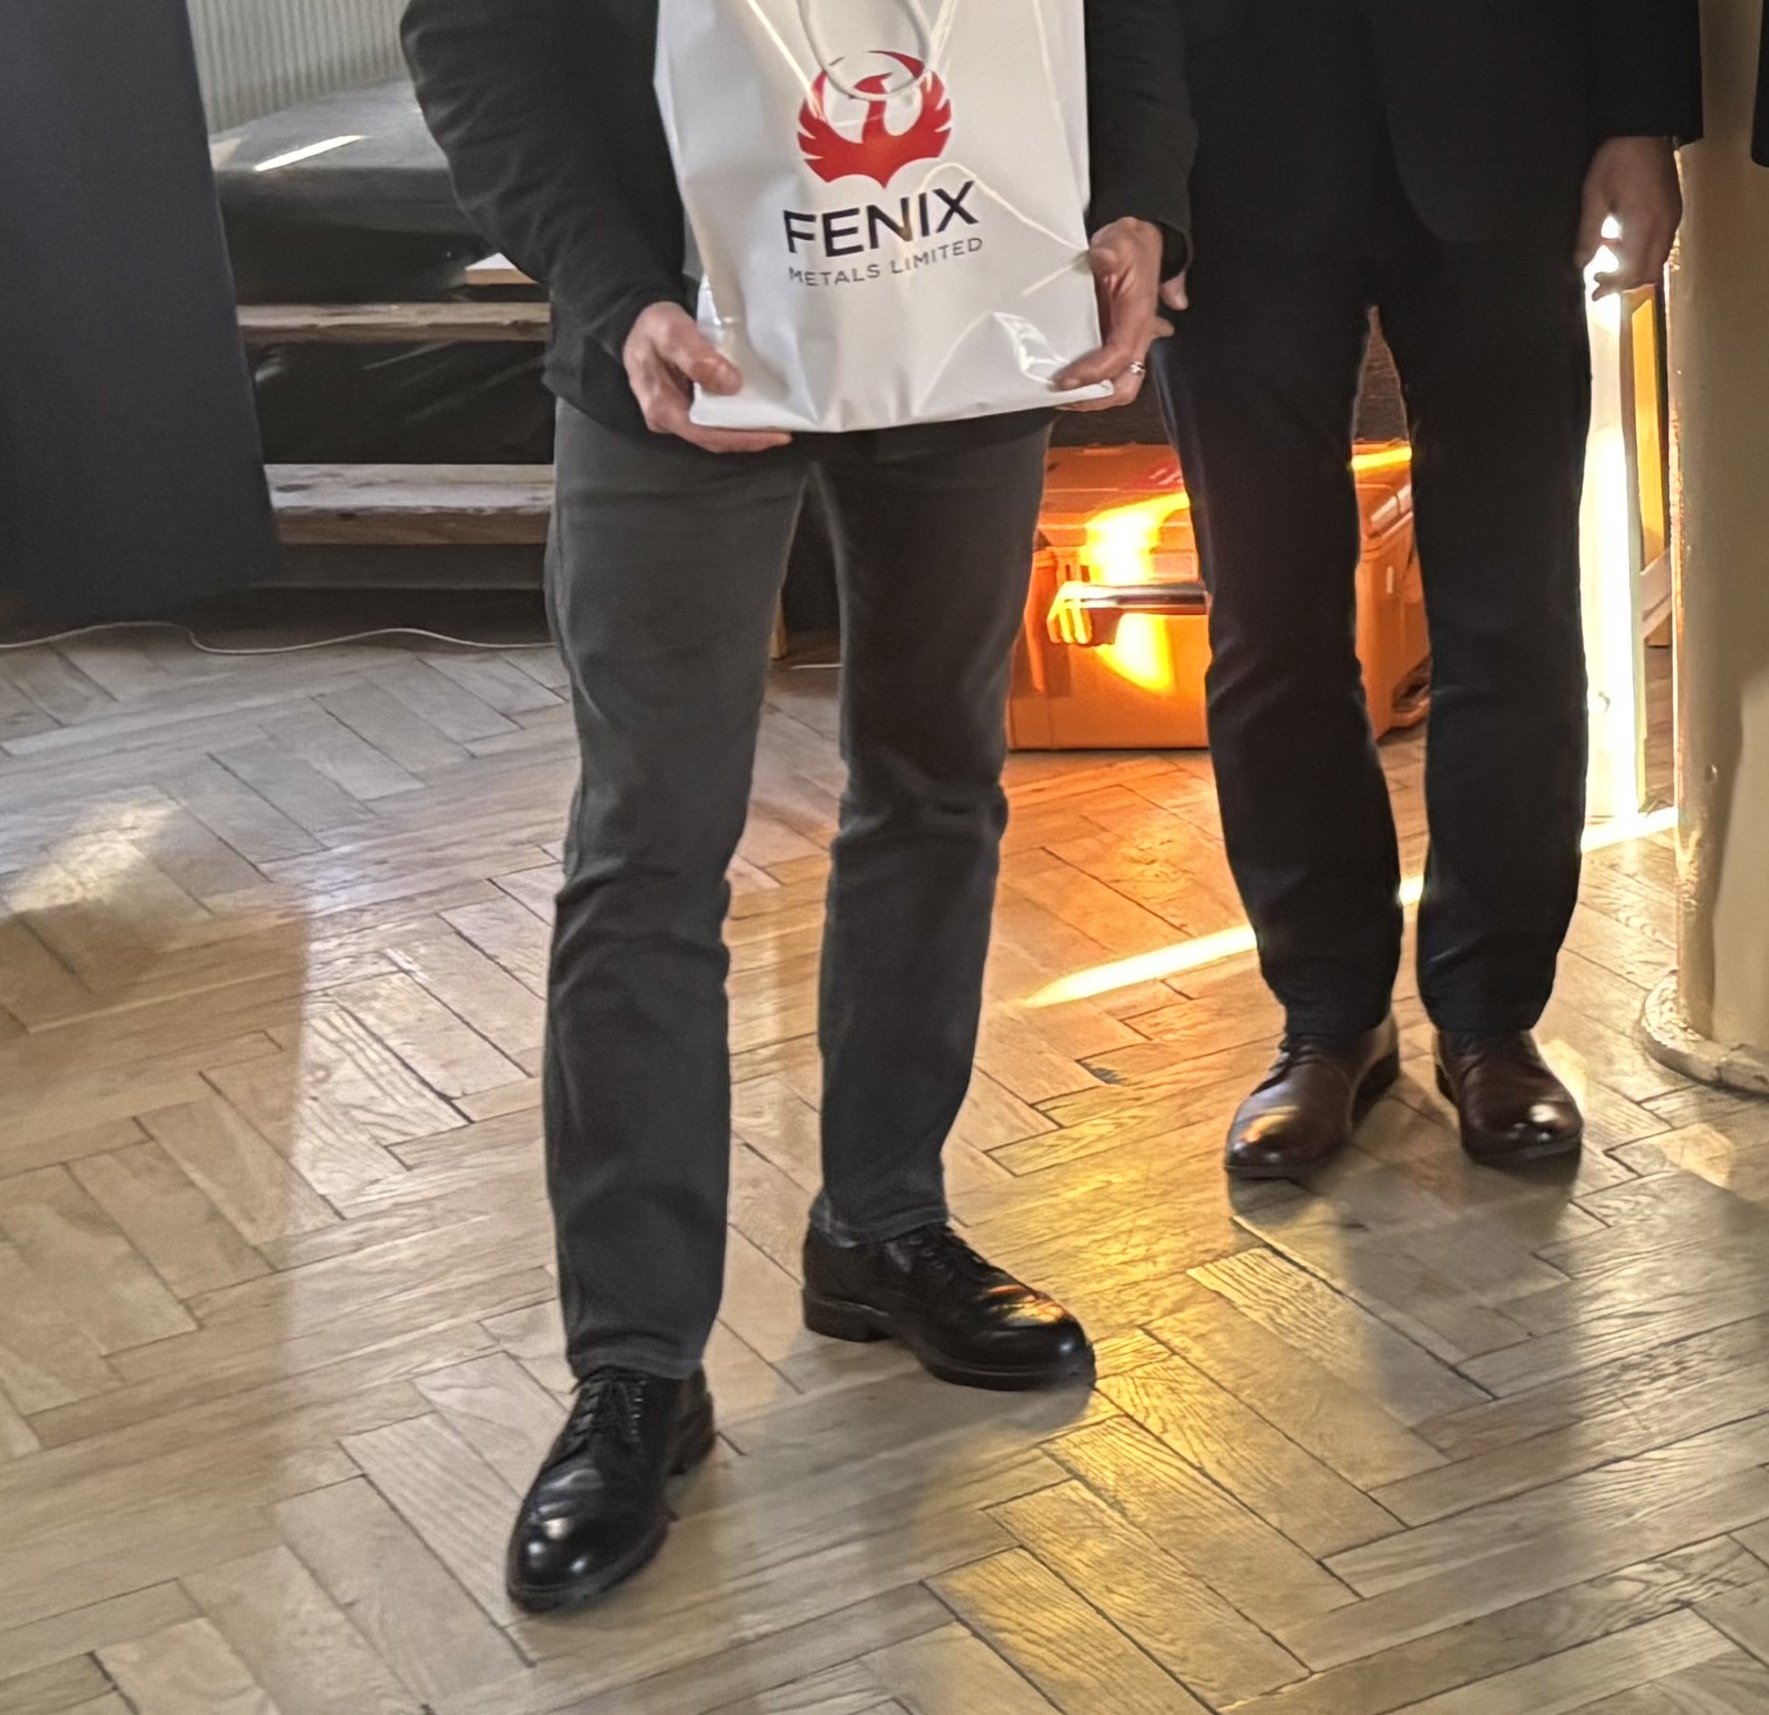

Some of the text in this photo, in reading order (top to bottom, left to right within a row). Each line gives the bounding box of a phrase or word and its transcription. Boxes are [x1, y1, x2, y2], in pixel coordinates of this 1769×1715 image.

[783, 179, 980, 258] FENIX
[788, 237, 984, 287] METALS LIMITED
